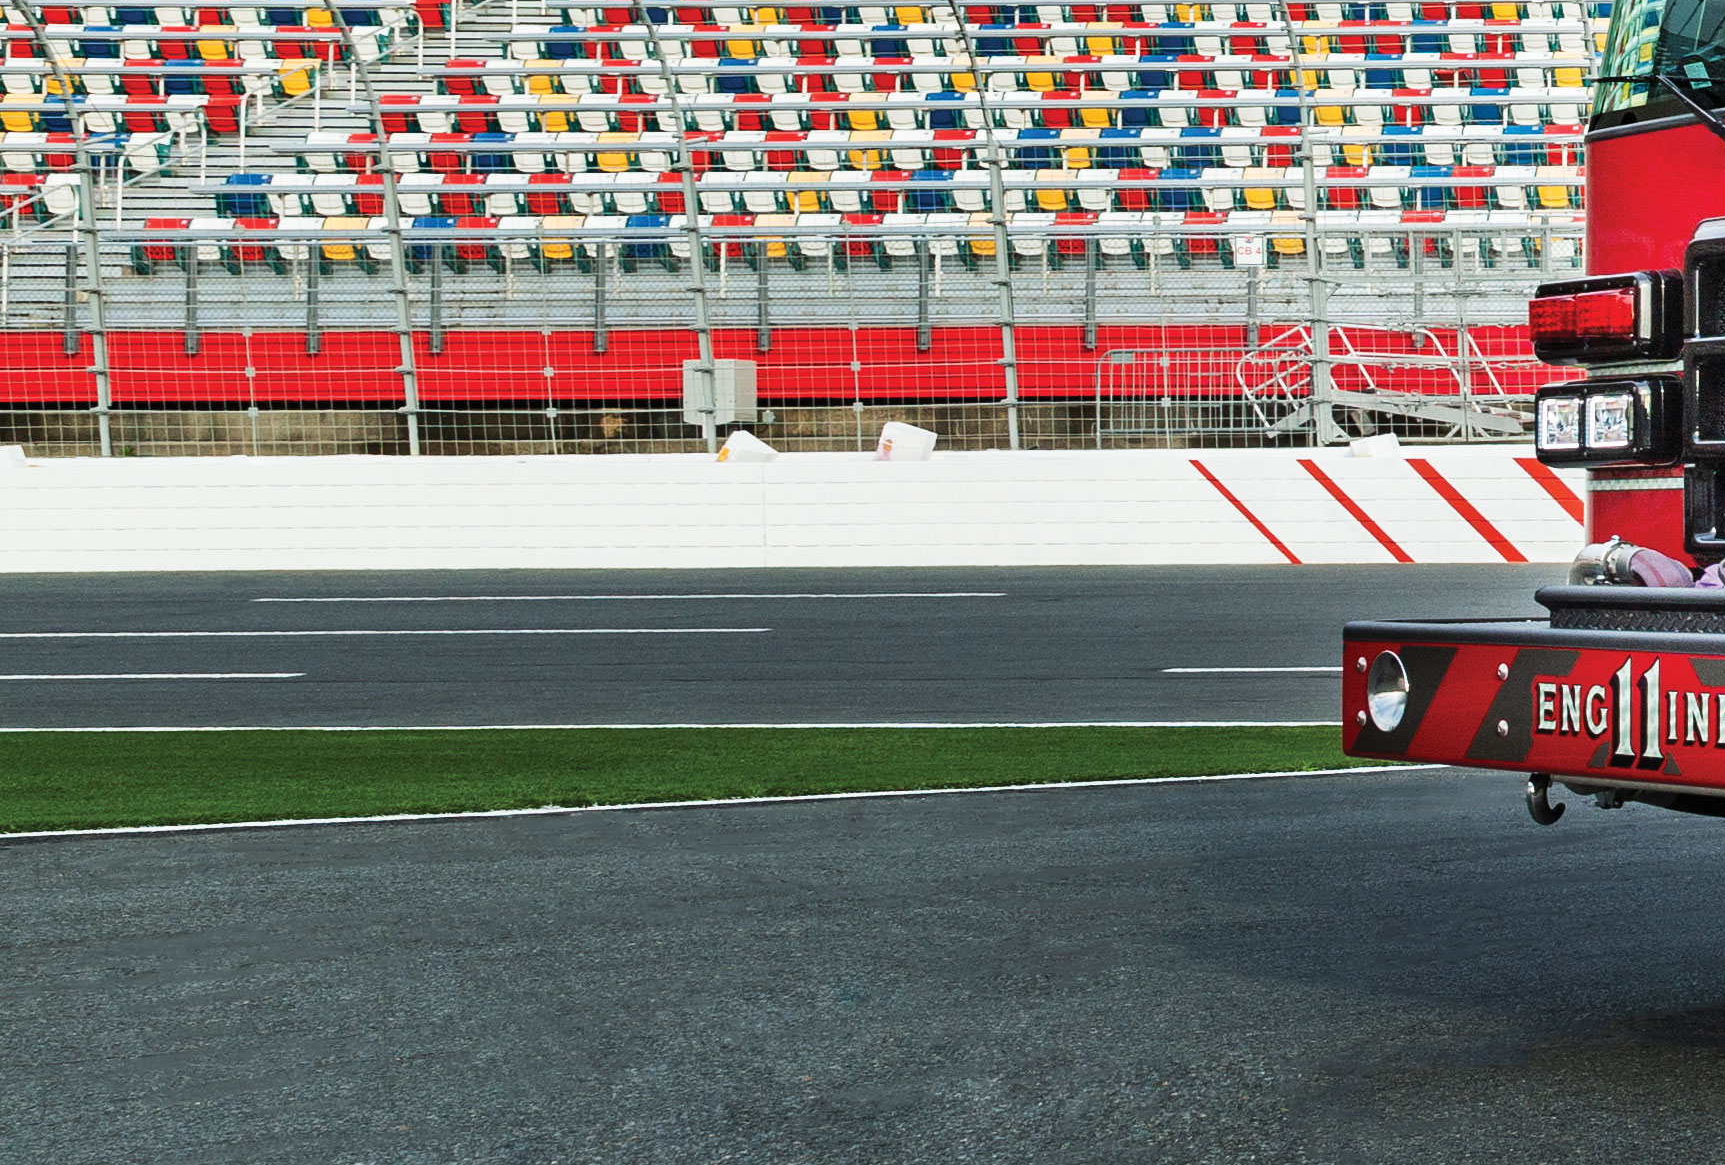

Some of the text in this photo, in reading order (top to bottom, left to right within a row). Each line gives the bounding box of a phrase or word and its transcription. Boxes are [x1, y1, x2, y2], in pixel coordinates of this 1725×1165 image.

[1237, 246, 1262, 255] CB 4
[1609, 655, 1662, 770] 11
